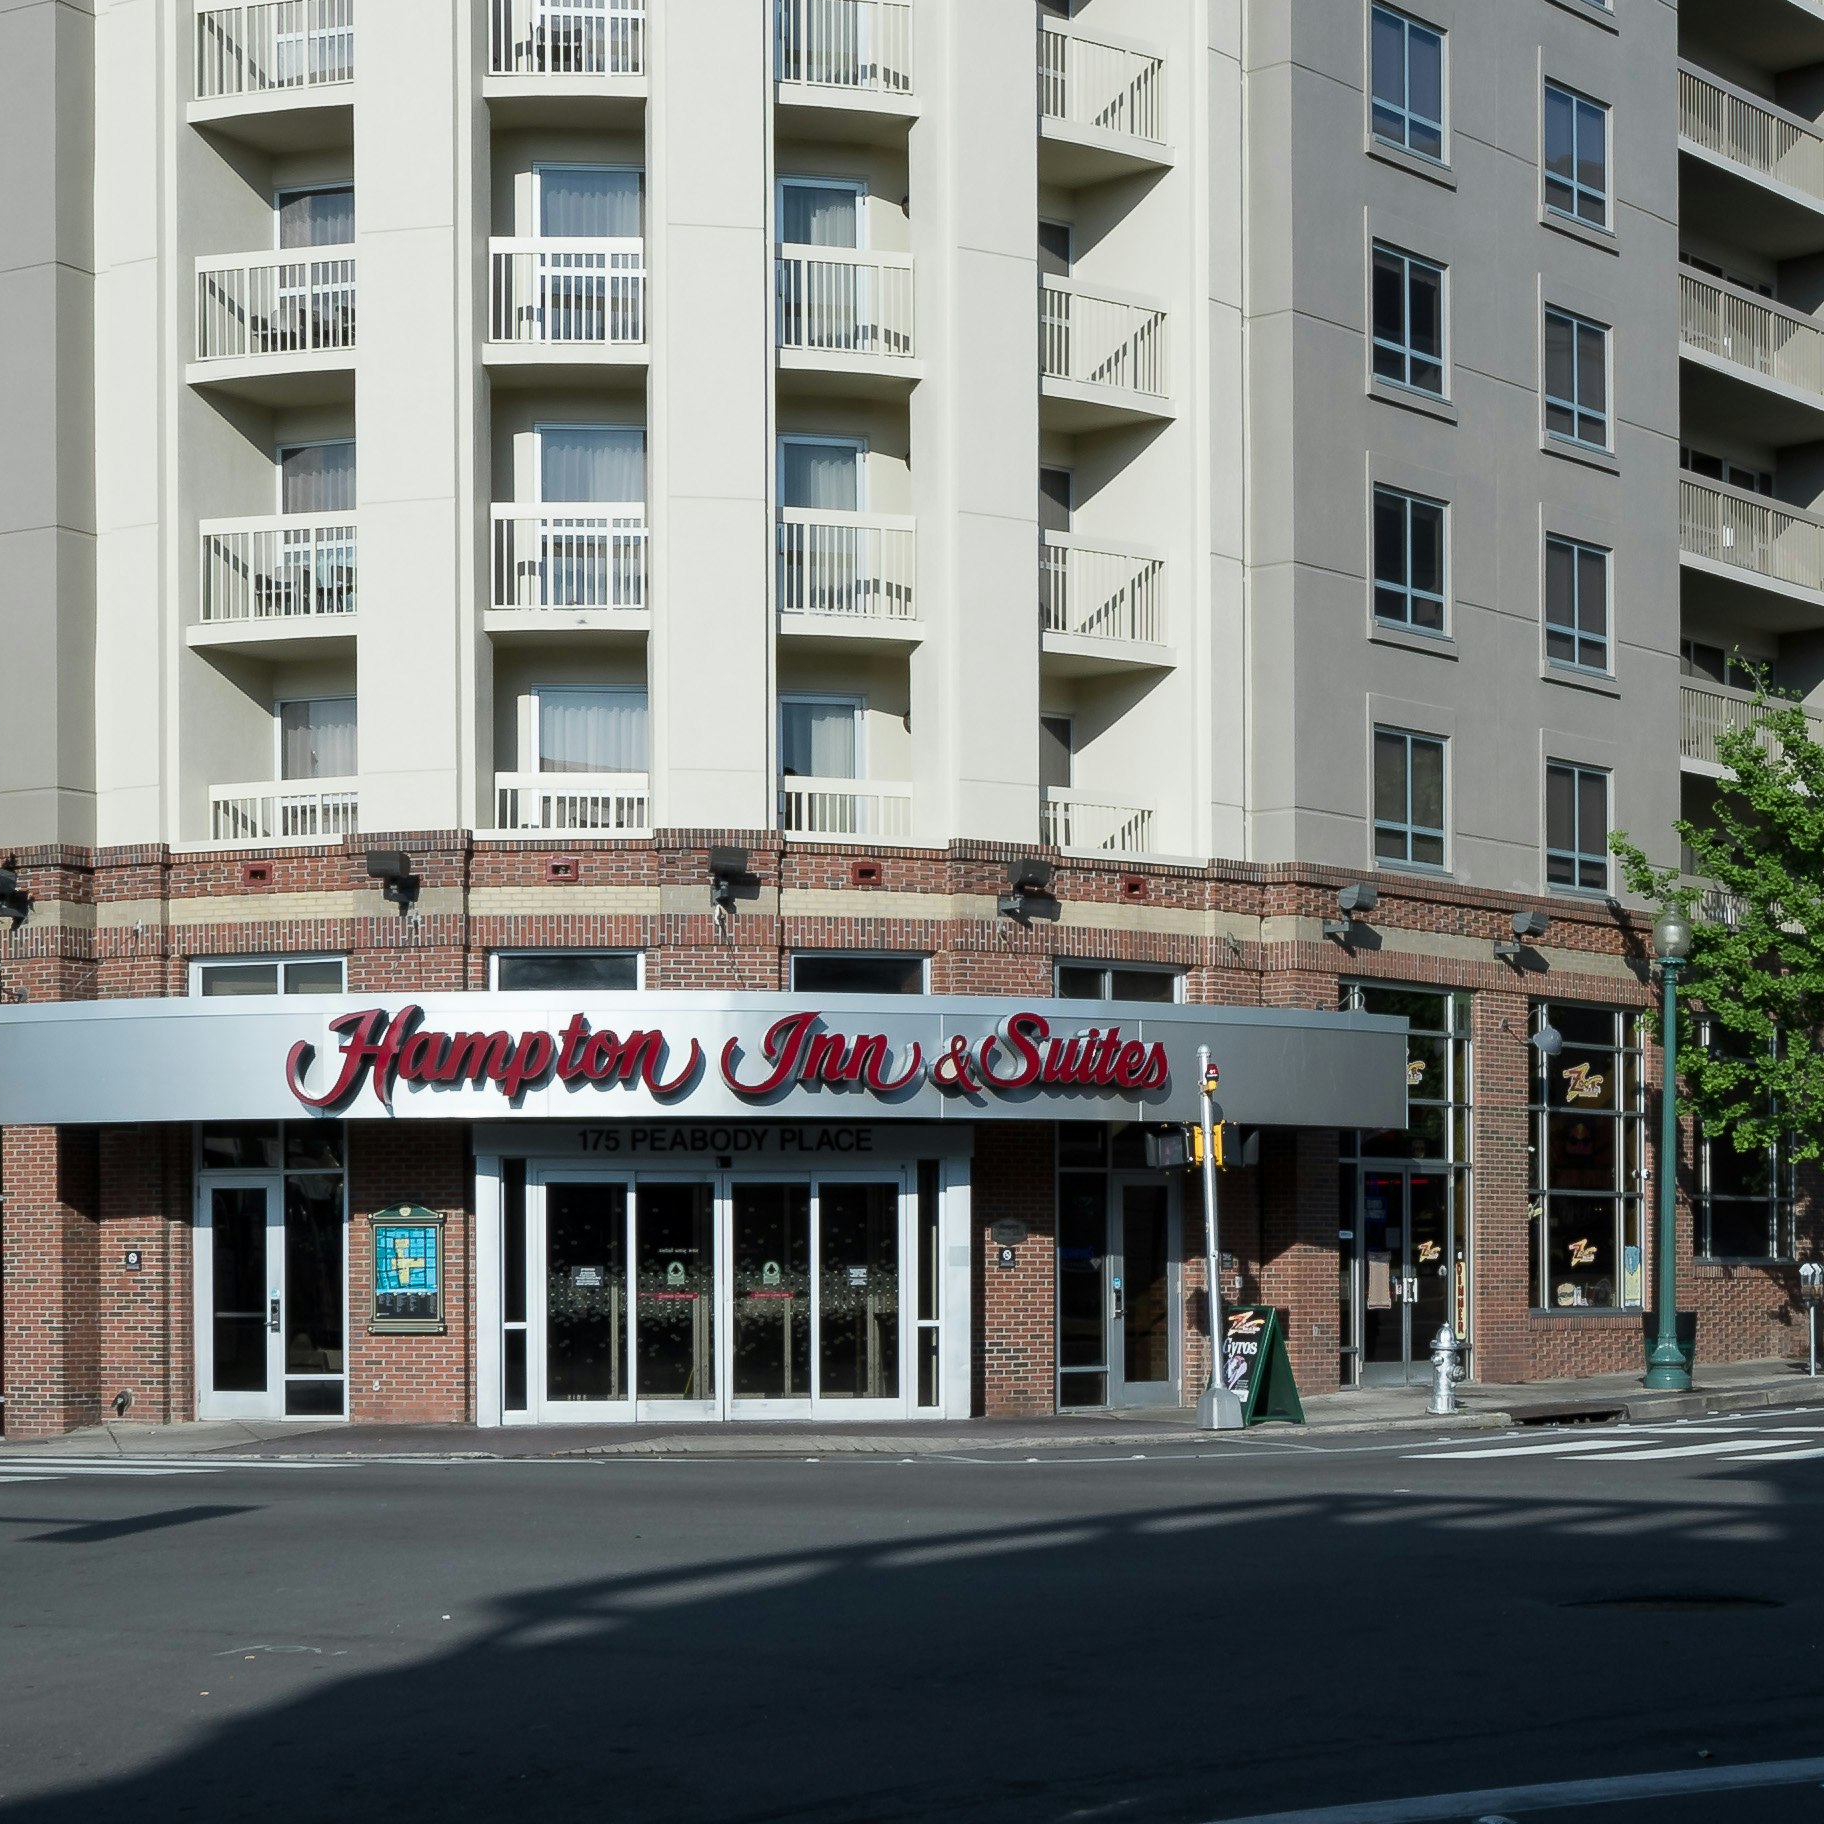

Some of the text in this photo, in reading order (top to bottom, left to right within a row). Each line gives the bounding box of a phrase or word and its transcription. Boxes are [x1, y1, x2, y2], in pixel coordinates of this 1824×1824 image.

[285, 1003, 1170, 1118] Hampton Inn & Suites
[577, 1128, 873, 1152] 175 PEABODY PLACE
[1223, 1336, 1258, 1358] Gyros
